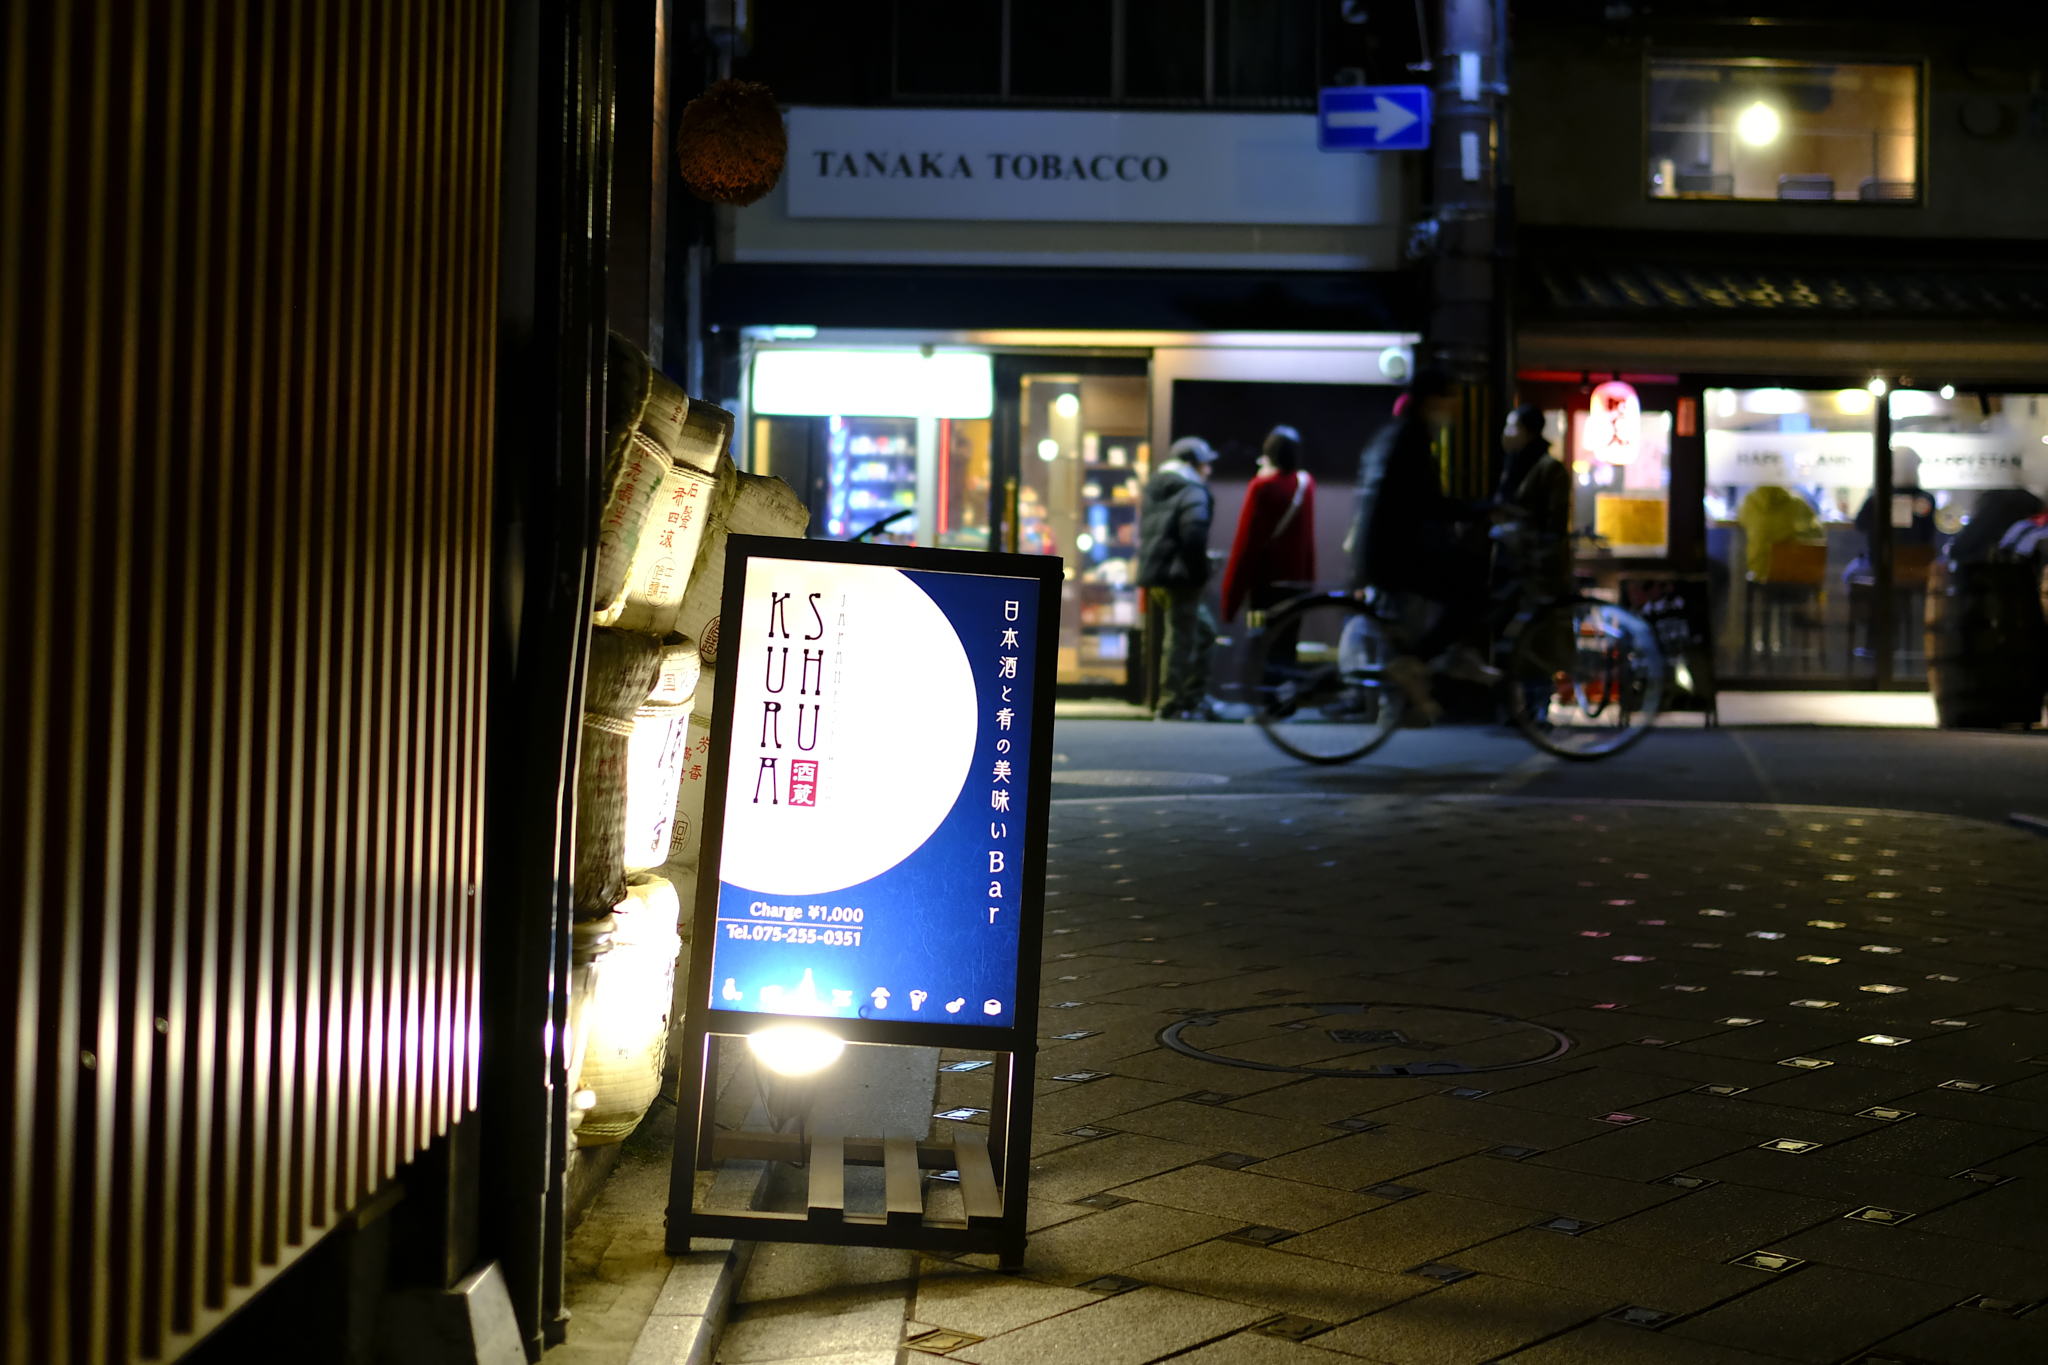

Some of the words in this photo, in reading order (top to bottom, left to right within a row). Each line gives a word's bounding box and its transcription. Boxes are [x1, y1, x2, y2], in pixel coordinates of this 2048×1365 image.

[813, 150, 974, 179] TANAKA
[986, 152, 1169, 182] TOBACCO
[790, 760, 818, 806] 酒蔵
[750, 901, 803, 922] Charge
[807, 904, 864, 923] ¥1,000
[726, 923, 861, 947] Tel.075-255-0351
